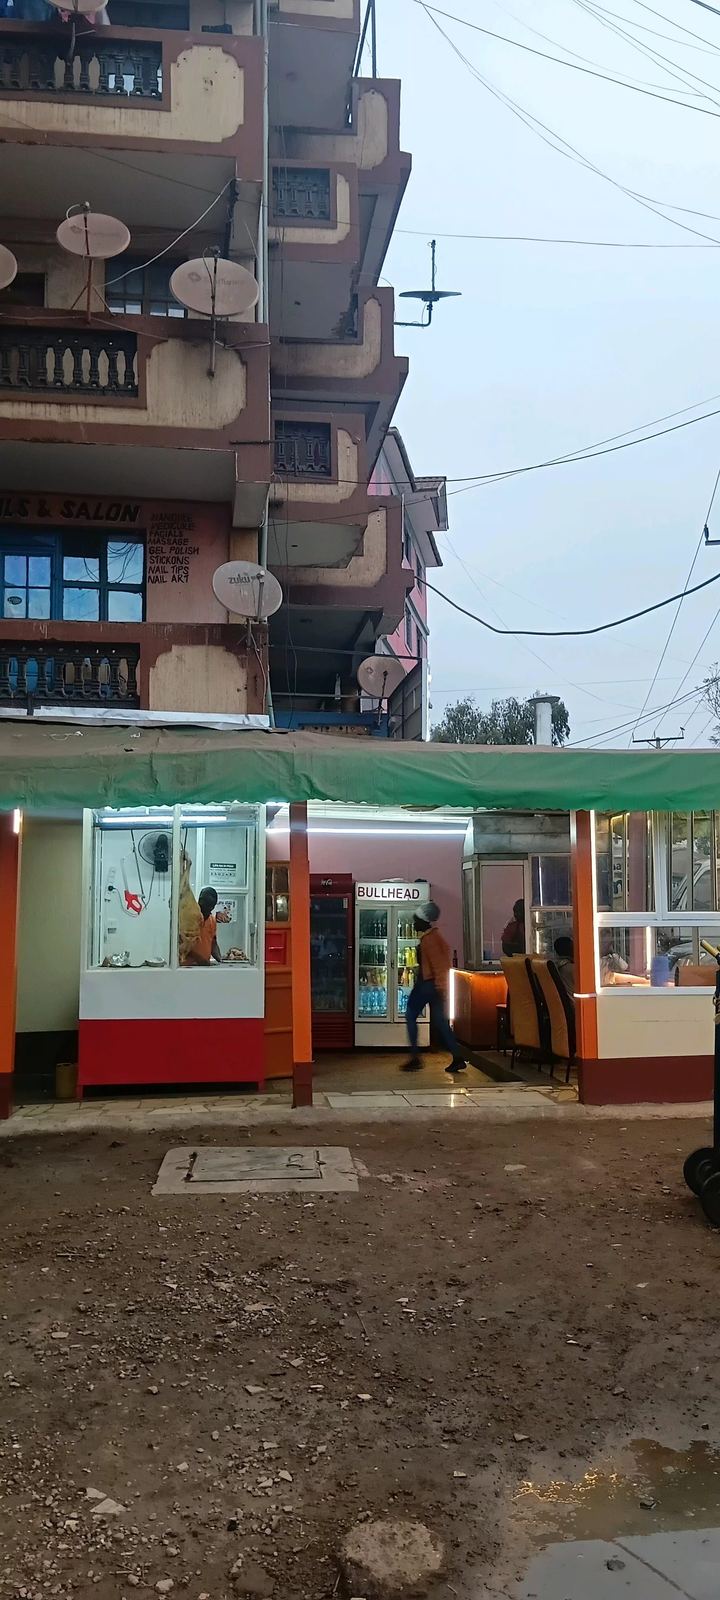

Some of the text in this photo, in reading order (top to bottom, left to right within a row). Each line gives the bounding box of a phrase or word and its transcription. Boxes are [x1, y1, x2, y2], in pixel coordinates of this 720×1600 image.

[38, 498, 52, 518] &
[60, 500, 140, 522] SALON
[149, 530, 183, 538] FACIALS
[147, 538, 189, 546] MASSAGE
[149, 546, 199, 556] GEL POLISH
[149, 555, 190, 565] STICKONS
[148, 565, 189, 574] NAIL TIPS
[148, 574, 189, 584] NAIL ART
[357, 886, 420, 900] BULLHEAD
